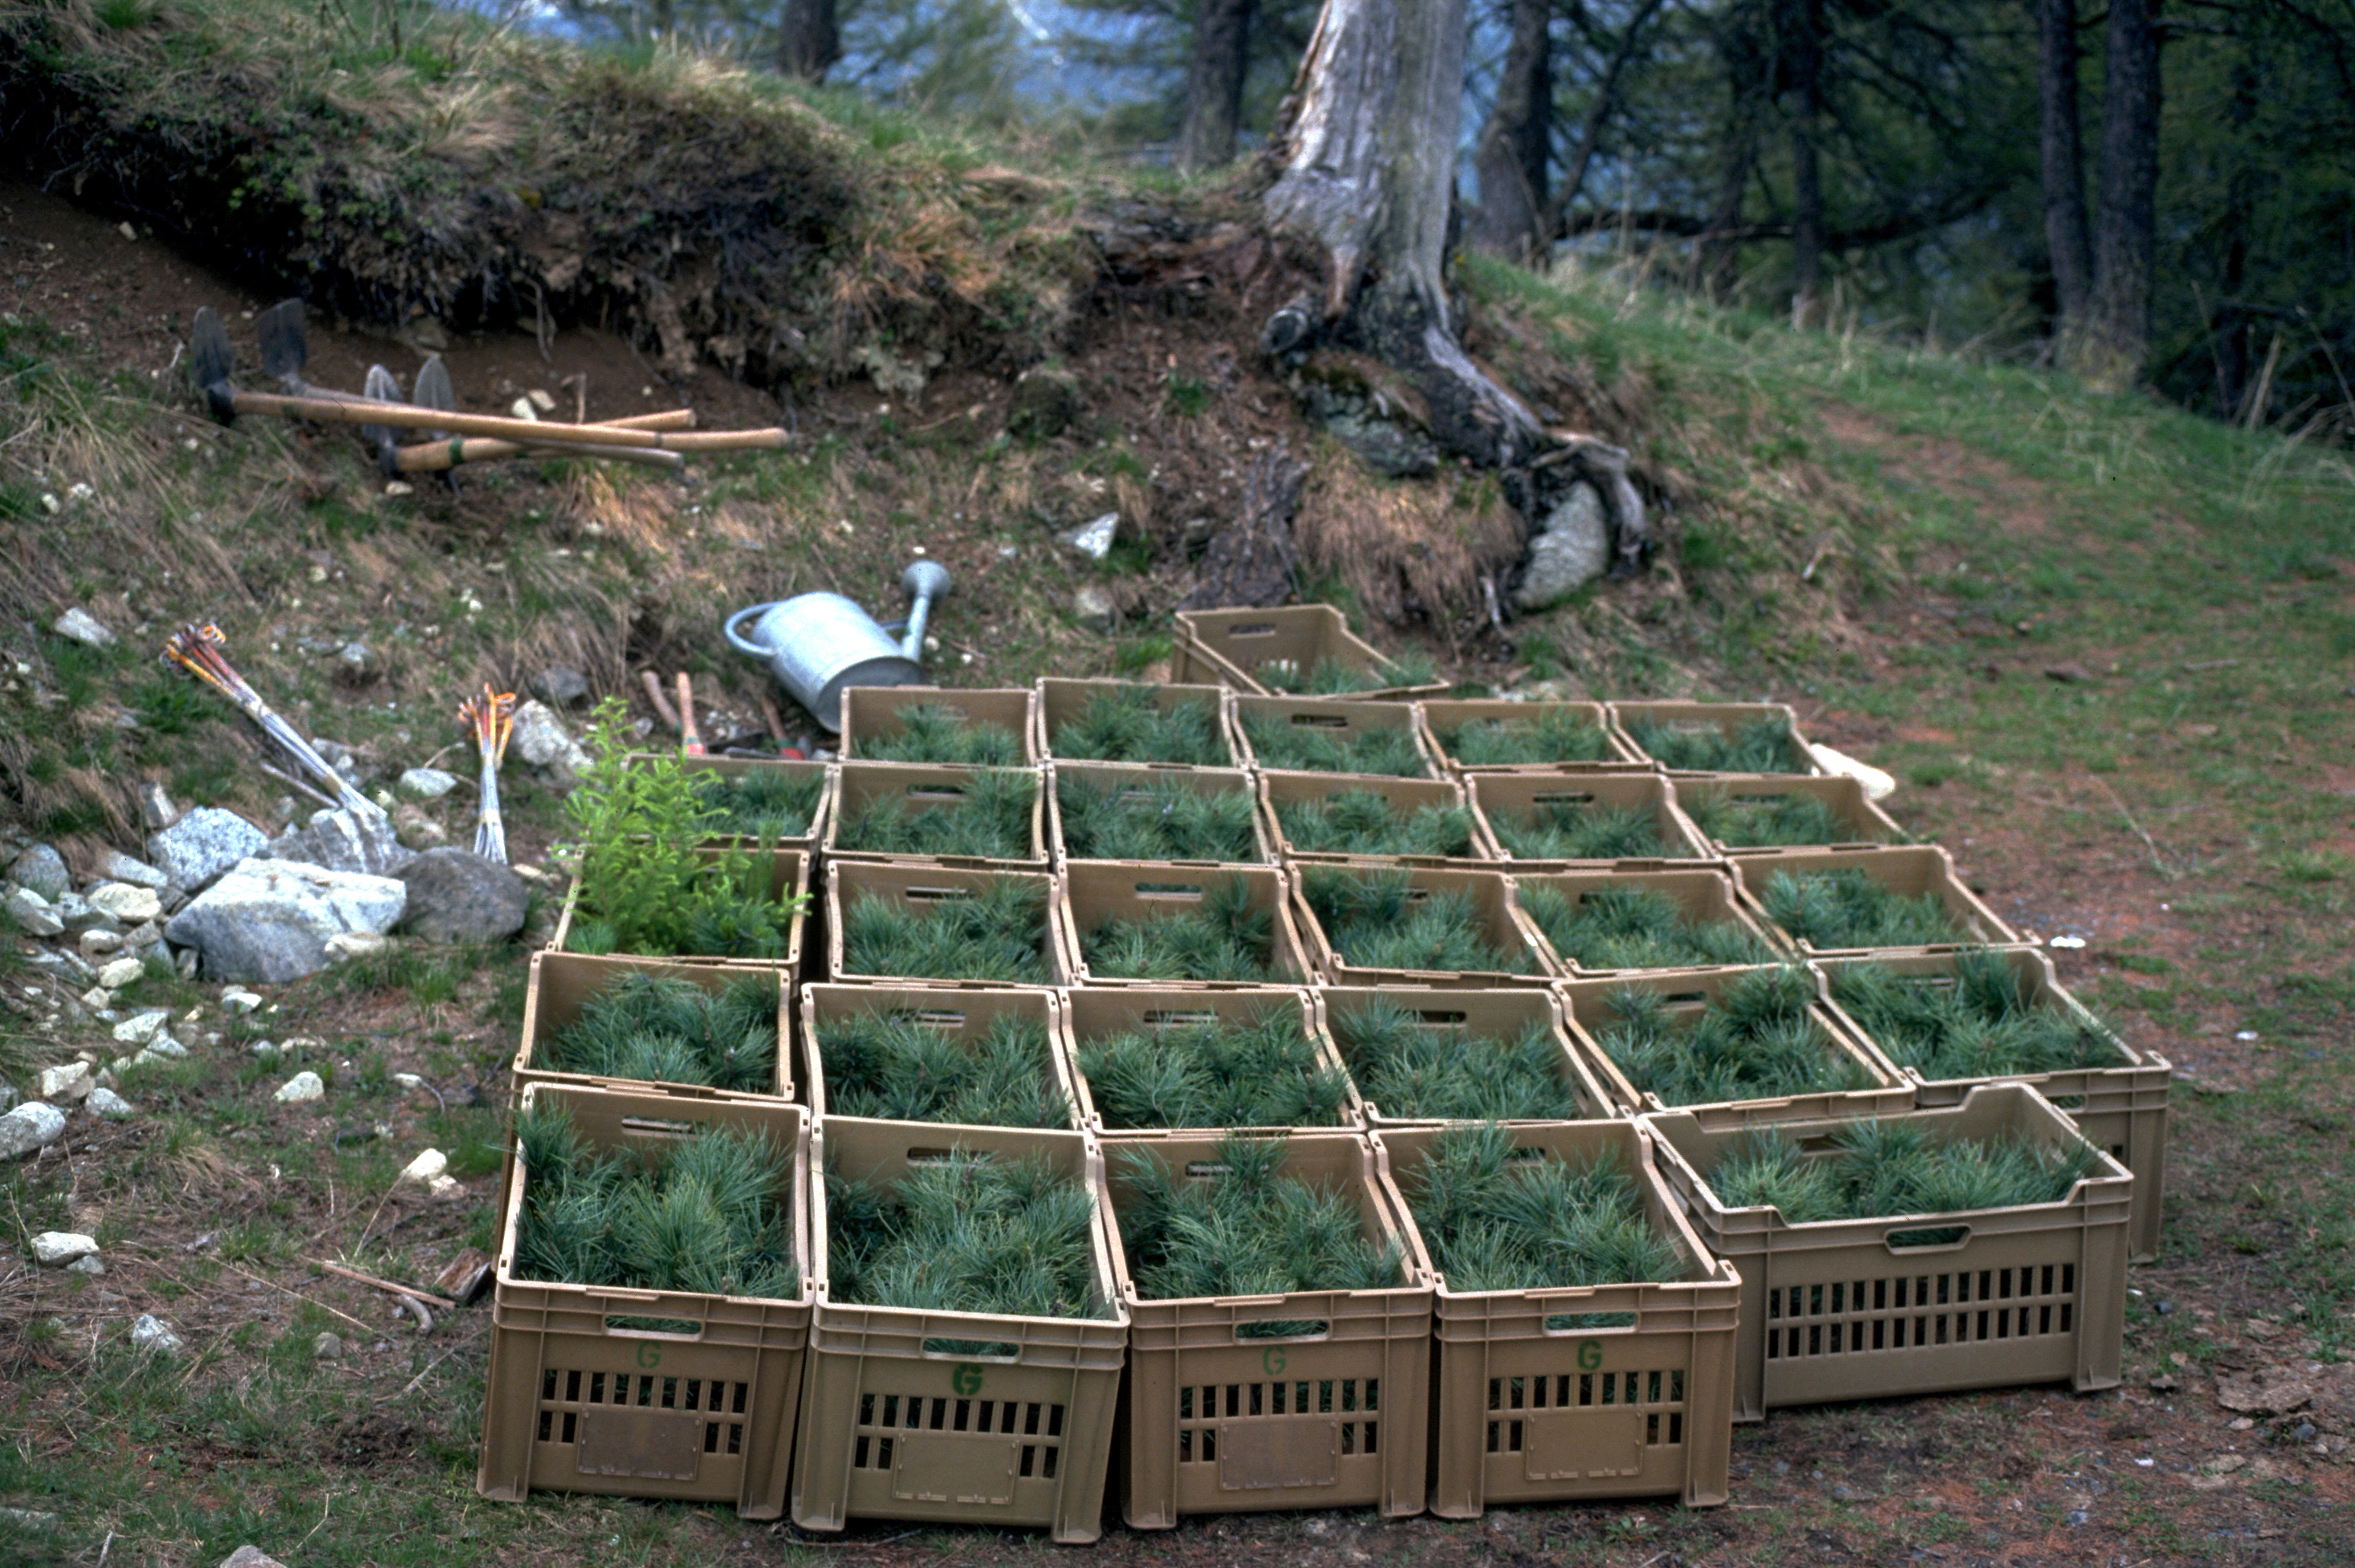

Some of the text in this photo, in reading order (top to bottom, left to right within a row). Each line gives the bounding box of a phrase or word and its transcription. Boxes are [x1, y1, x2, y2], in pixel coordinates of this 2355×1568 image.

[637, 1340, 661, 1368] G
[1263, 1346, 1287, 1375] G
[1578, 1339, 1602, 1371] G
[953, 1363, 983, 1395] G
